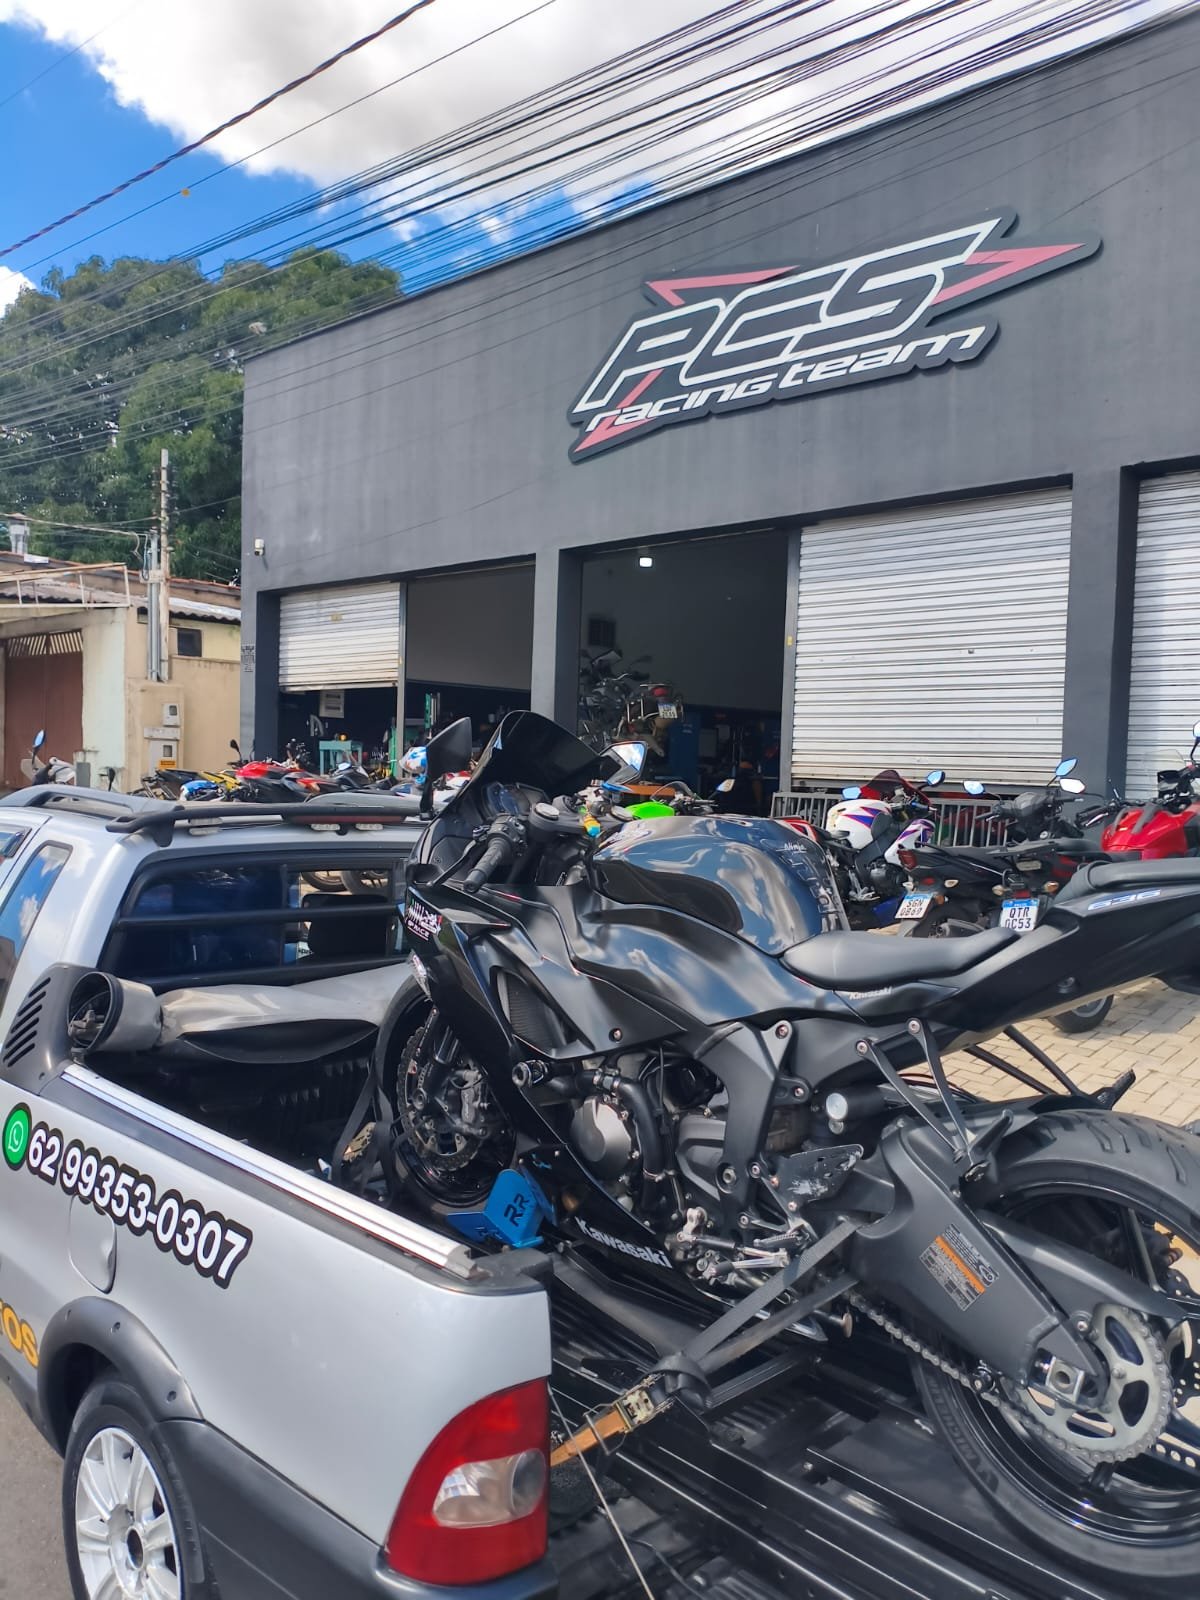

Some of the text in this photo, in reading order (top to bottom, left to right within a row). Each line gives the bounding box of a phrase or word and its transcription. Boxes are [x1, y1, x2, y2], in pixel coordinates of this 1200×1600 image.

[778, 325, 986, 389] team
[1087, 889, 1161, 911] 636
[28, 1128, 248, 1280] 62 99353-0307
[503, 1193, 530, 1227] RR
[574, 1216, 673, 1269] Kawasaki
[0, 1300, 39, 1368] OS
